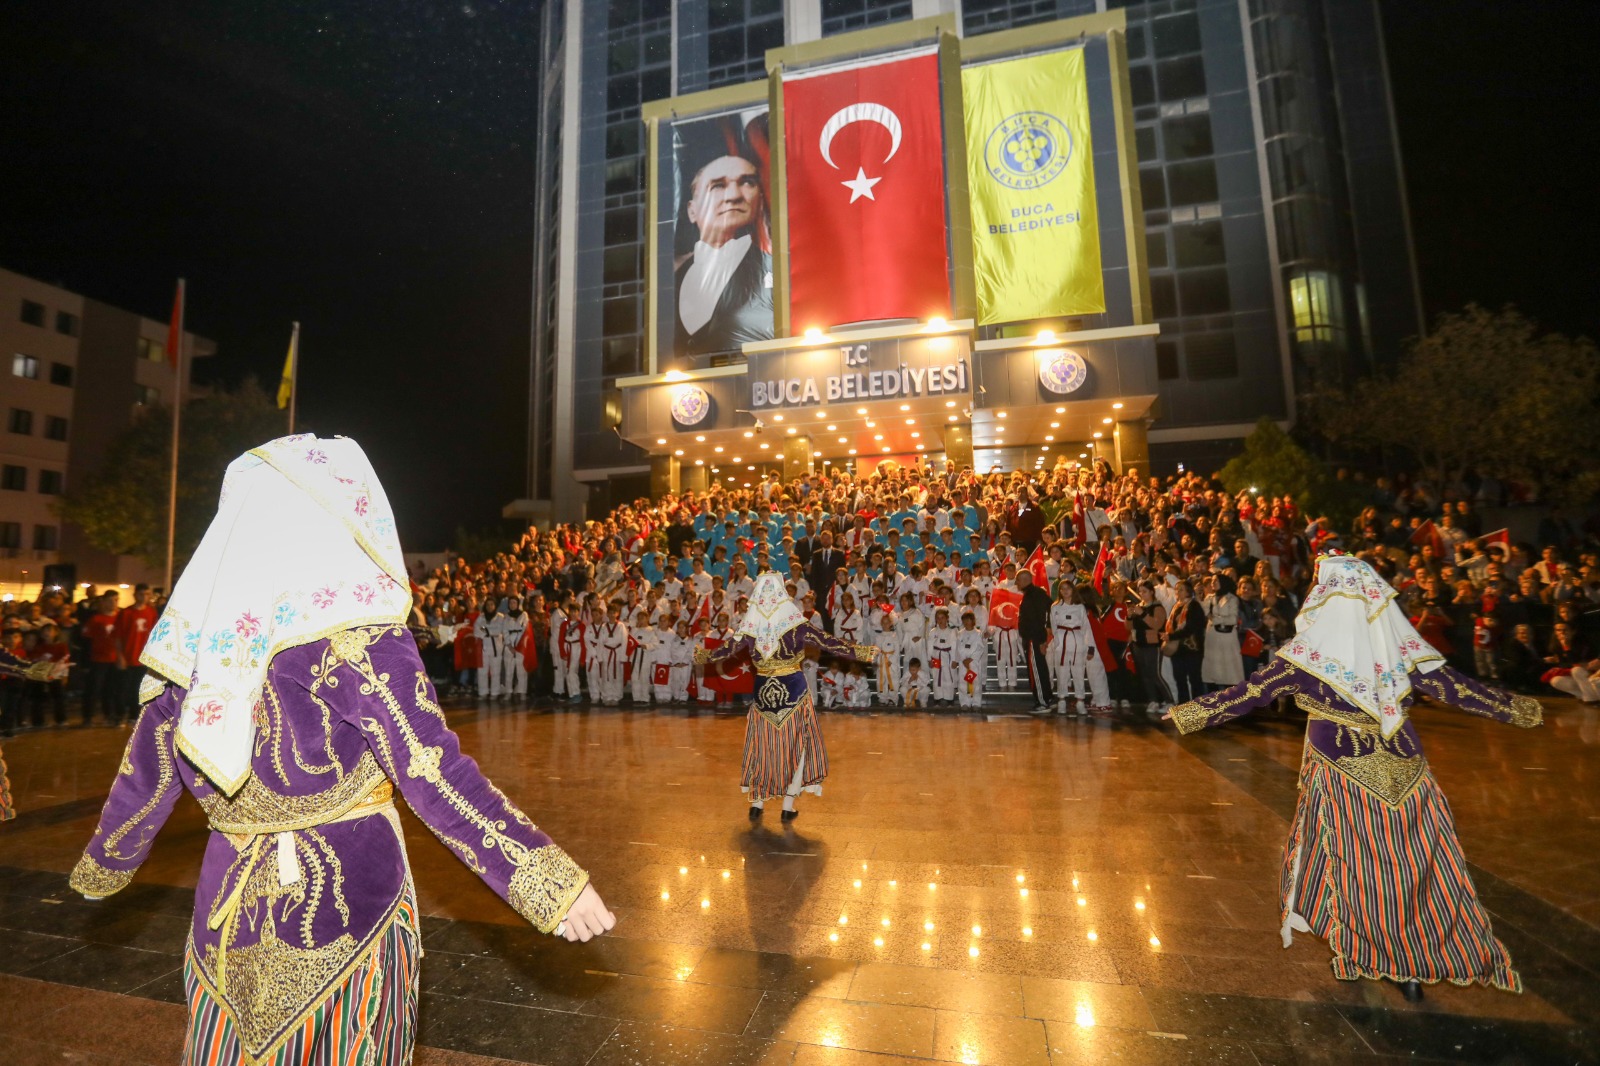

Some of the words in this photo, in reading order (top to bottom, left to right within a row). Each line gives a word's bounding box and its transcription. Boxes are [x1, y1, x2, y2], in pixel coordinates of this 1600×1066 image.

[1001, 115, 1050, 134] BUCA
[989, 209, 1080, 234] BELEDİYESİ
[1011, 203, 1054, 218] BUCA
[752, 376, 820, 406] BUCA
[826, 358, 966, 400] BELEDİYESİ
